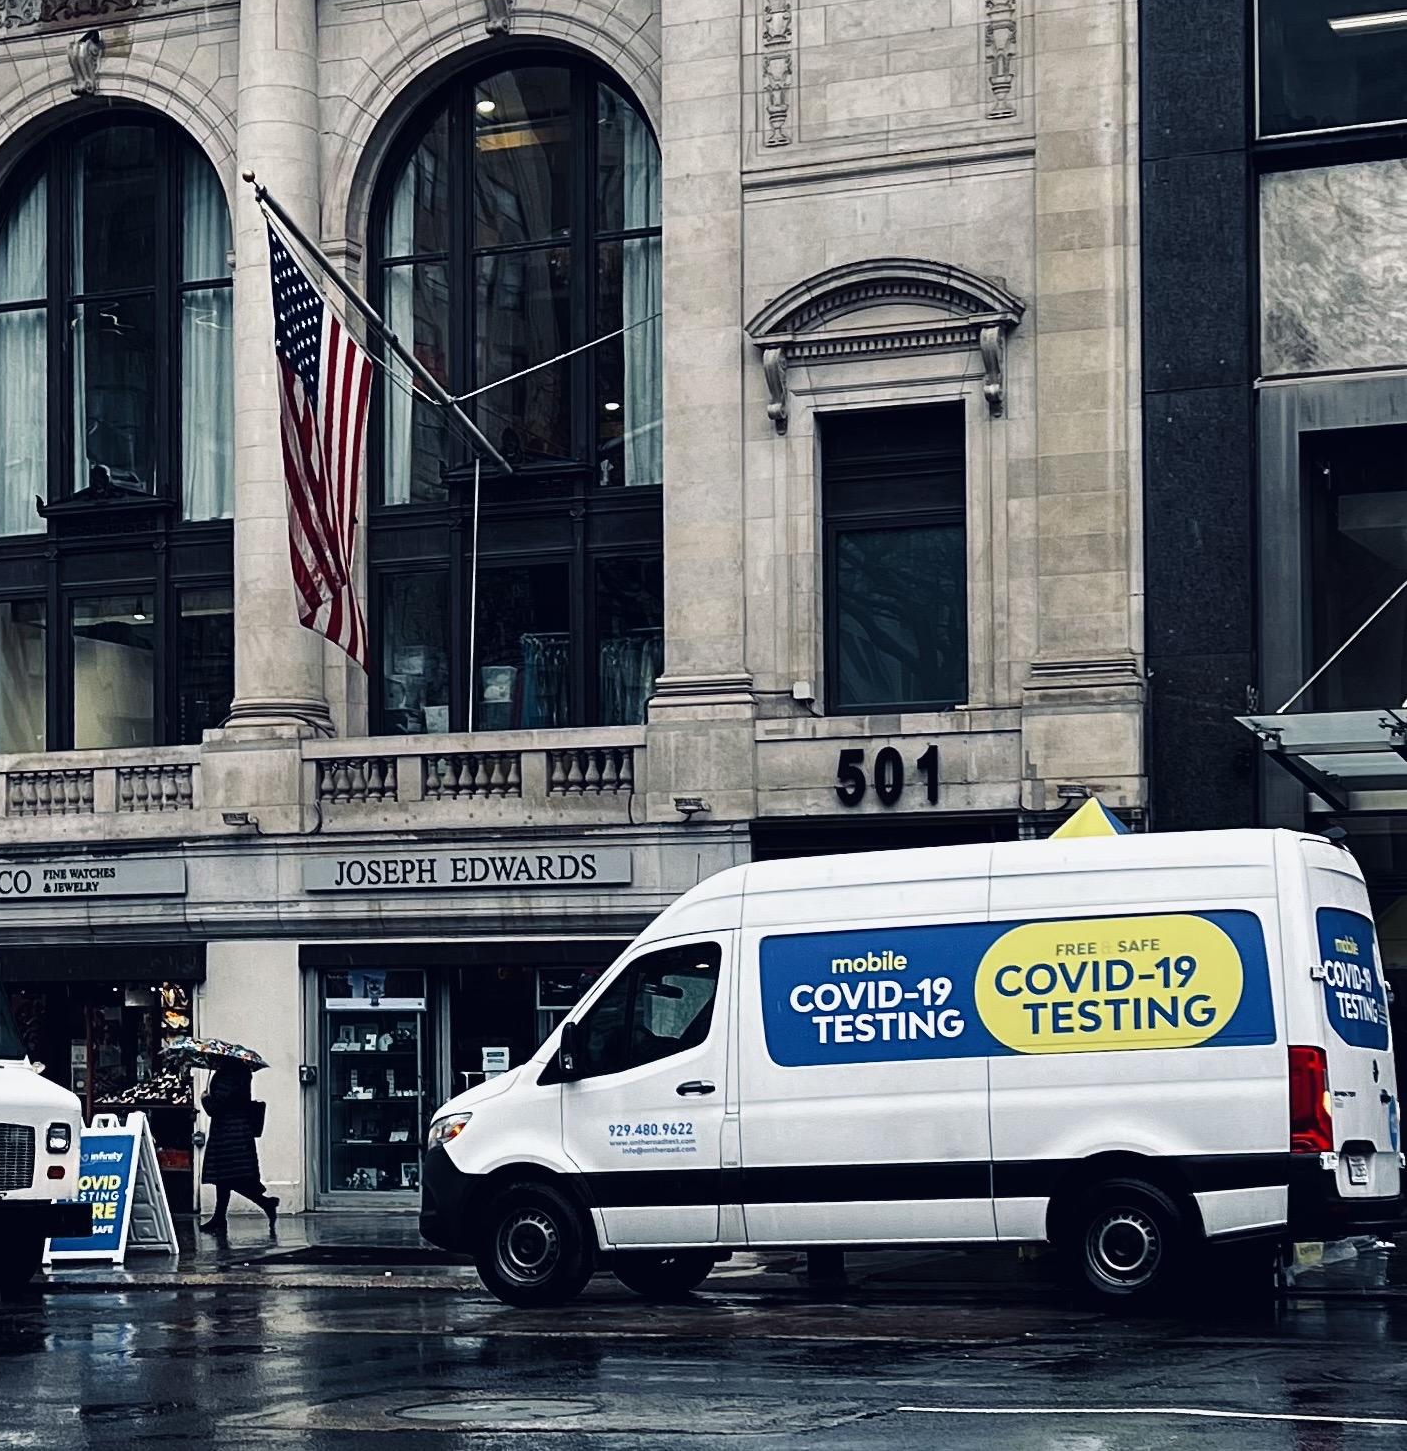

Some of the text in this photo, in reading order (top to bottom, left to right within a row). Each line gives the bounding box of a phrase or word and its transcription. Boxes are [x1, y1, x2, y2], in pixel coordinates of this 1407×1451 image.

[835, 744, 939, 807] 501
[43, 867, 116, 881] FINE WATCHES
[334, 853, 597, 886] JOSEPH EDWARDS
[43, 881, 99, 893] & JEWELRY
[831, 951, 908, 974] mobile
[1055, 942, 1097, 956] FREE
[1117, 938, 1160, 953] SAFE
[994, 955, 1197, 997] COVID-19
[1324, 959, 1372, 993] COVID-19
[789, 976, 953, 1013] COVID-19
[1334, 991, 1379, 1024] TESTING
[812, 1009, 965, 1044] TESTING
[1022, 994, 1217, 1035] TESTING
[608, 1122, 693, 1137] 929.480.9622
[78, 1175, 122, 1191] OVID
